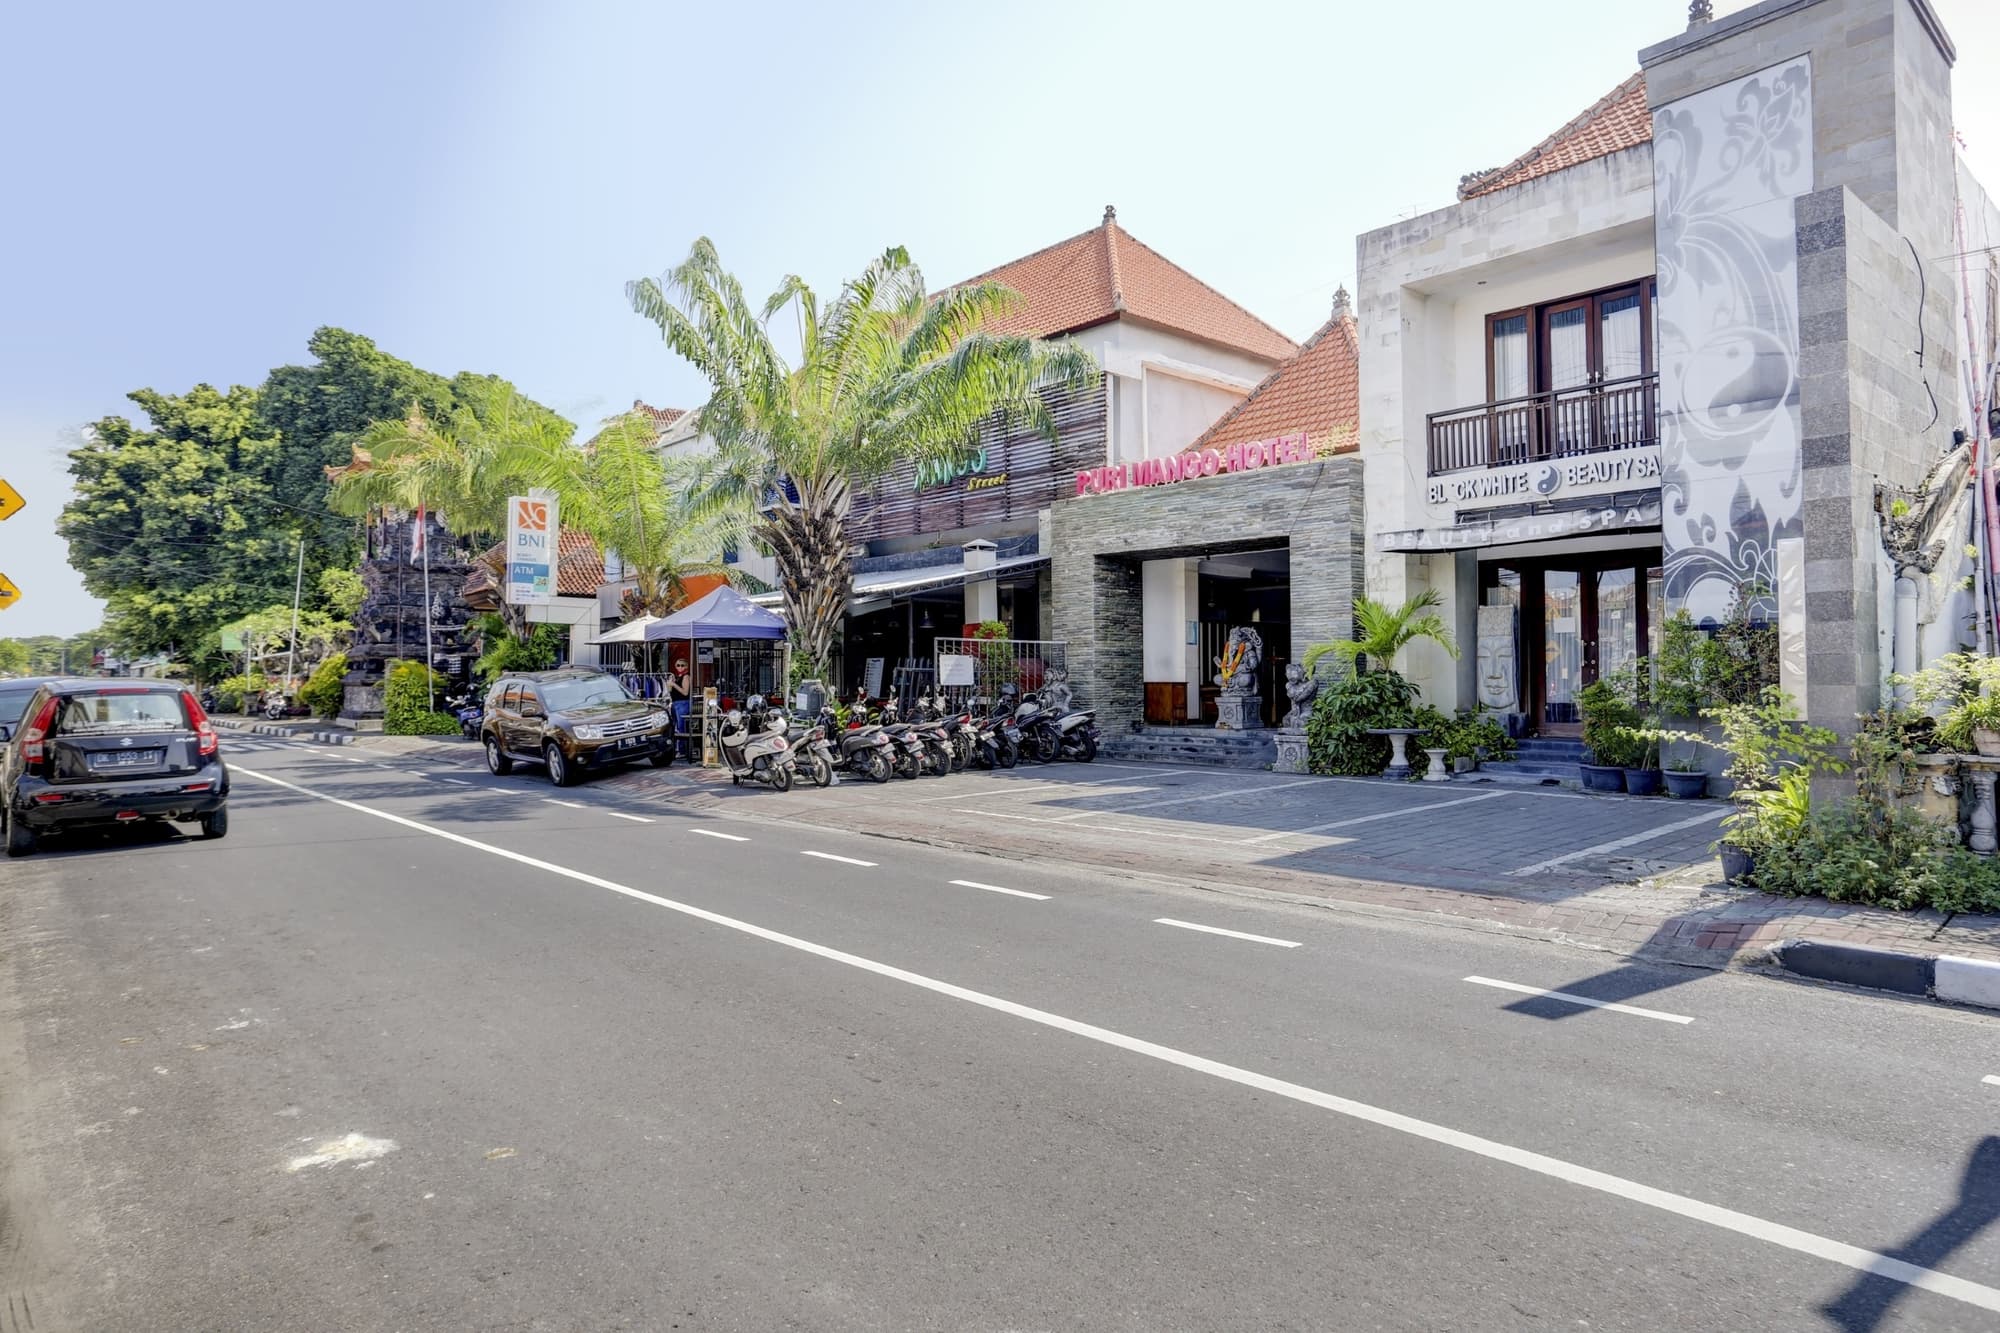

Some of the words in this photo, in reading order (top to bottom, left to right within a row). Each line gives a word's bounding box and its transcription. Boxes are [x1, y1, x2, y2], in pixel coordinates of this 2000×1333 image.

[1076, 464, 1128, 495] PURI
[1131, 448, 1220, 487] MANGO
[1226, 432, 1316, 473] HOTEL
[967, 473, 1008, 491] Street
[1480, 472, 1529, 496] WHITE
[1567, 457, 1633, 486] BEAUTY
[1384, 529, 1493, 548] BEAUTY
[1506, 518, 1564, 539] and
[1579, 508, 1643, 530] SPA
[518, 534, 545, 548] BNI
[514, 567, 534, 575] ATM
[536, 577, 547, 586] 24
